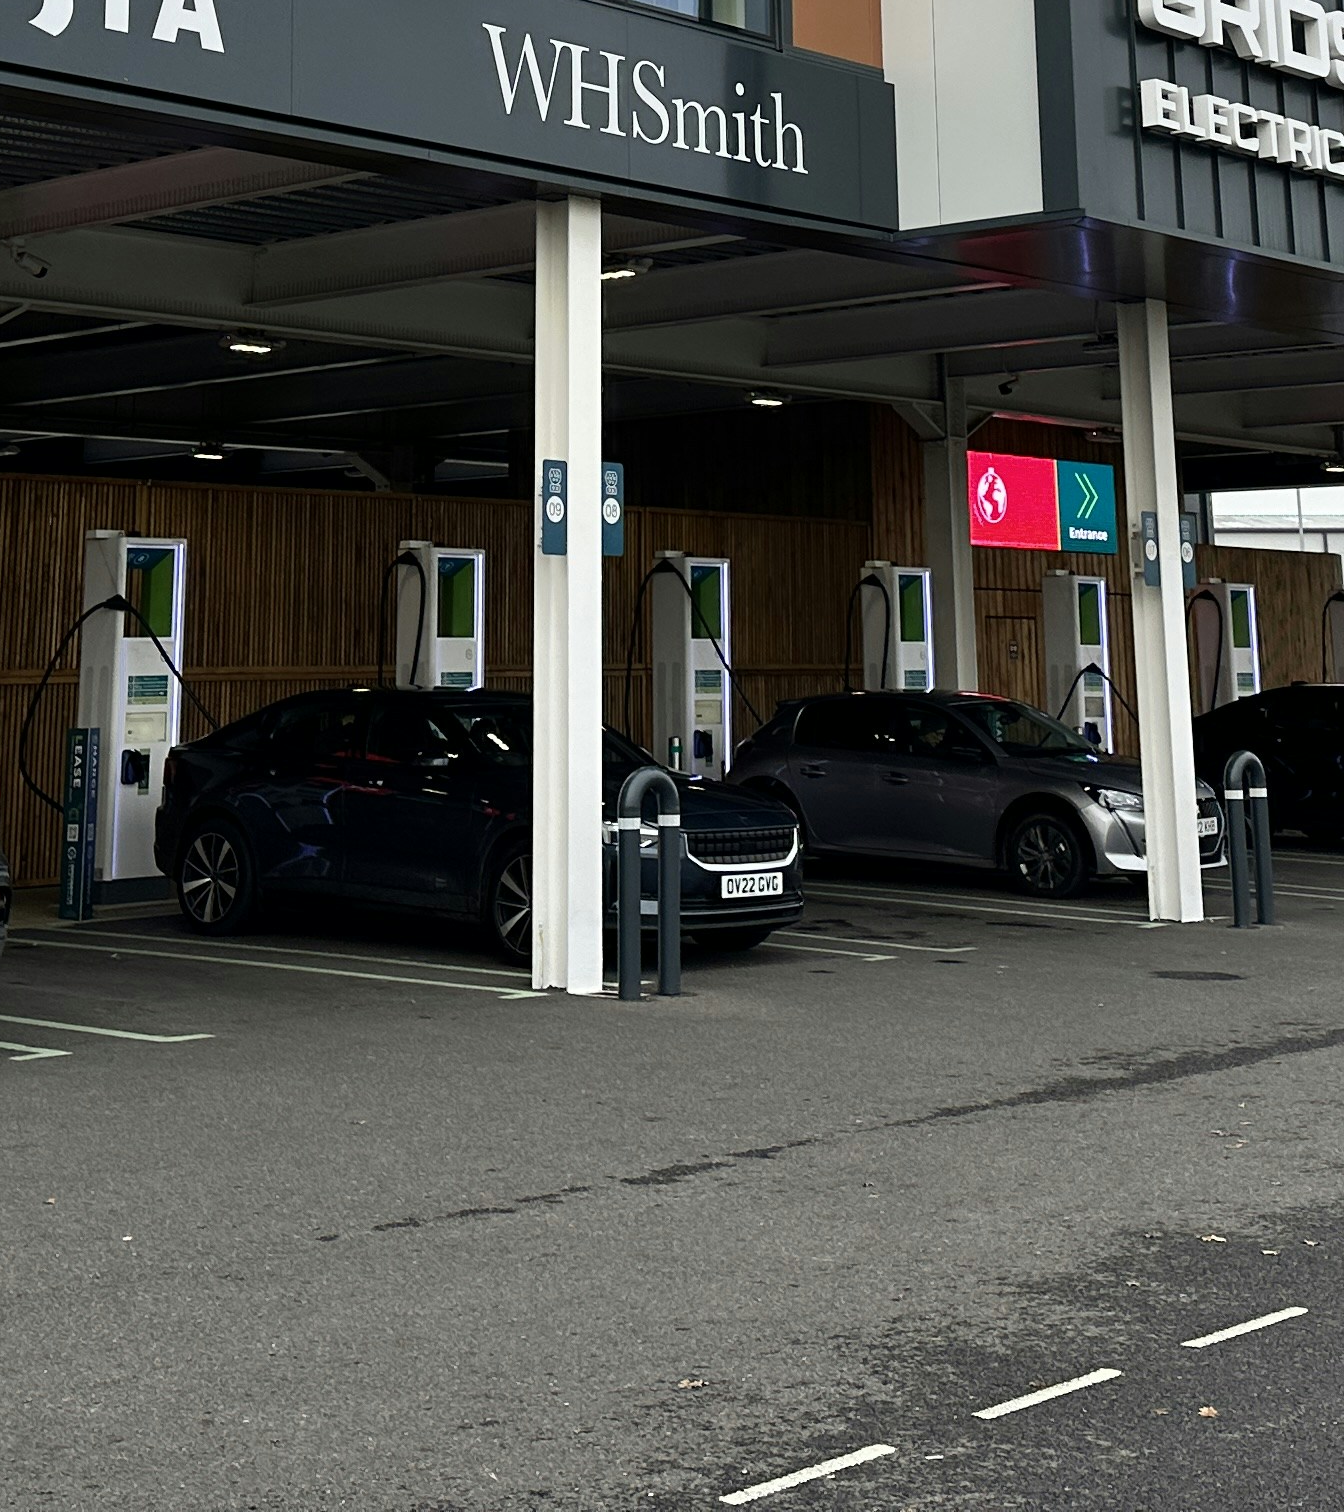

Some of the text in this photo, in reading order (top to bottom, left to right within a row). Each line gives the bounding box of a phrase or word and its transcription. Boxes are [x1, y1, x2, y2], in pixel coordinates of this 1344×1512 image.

[481, 22, 809, 175] WHSmith
[548, 502, 562, 517] 09
[605, 503, 618, 518] 08
[1068, 526, 1108, 542] Entrance
[72, 735, 83, 788] LEASE
[726, 875, 779, 895] OV22 GVG
